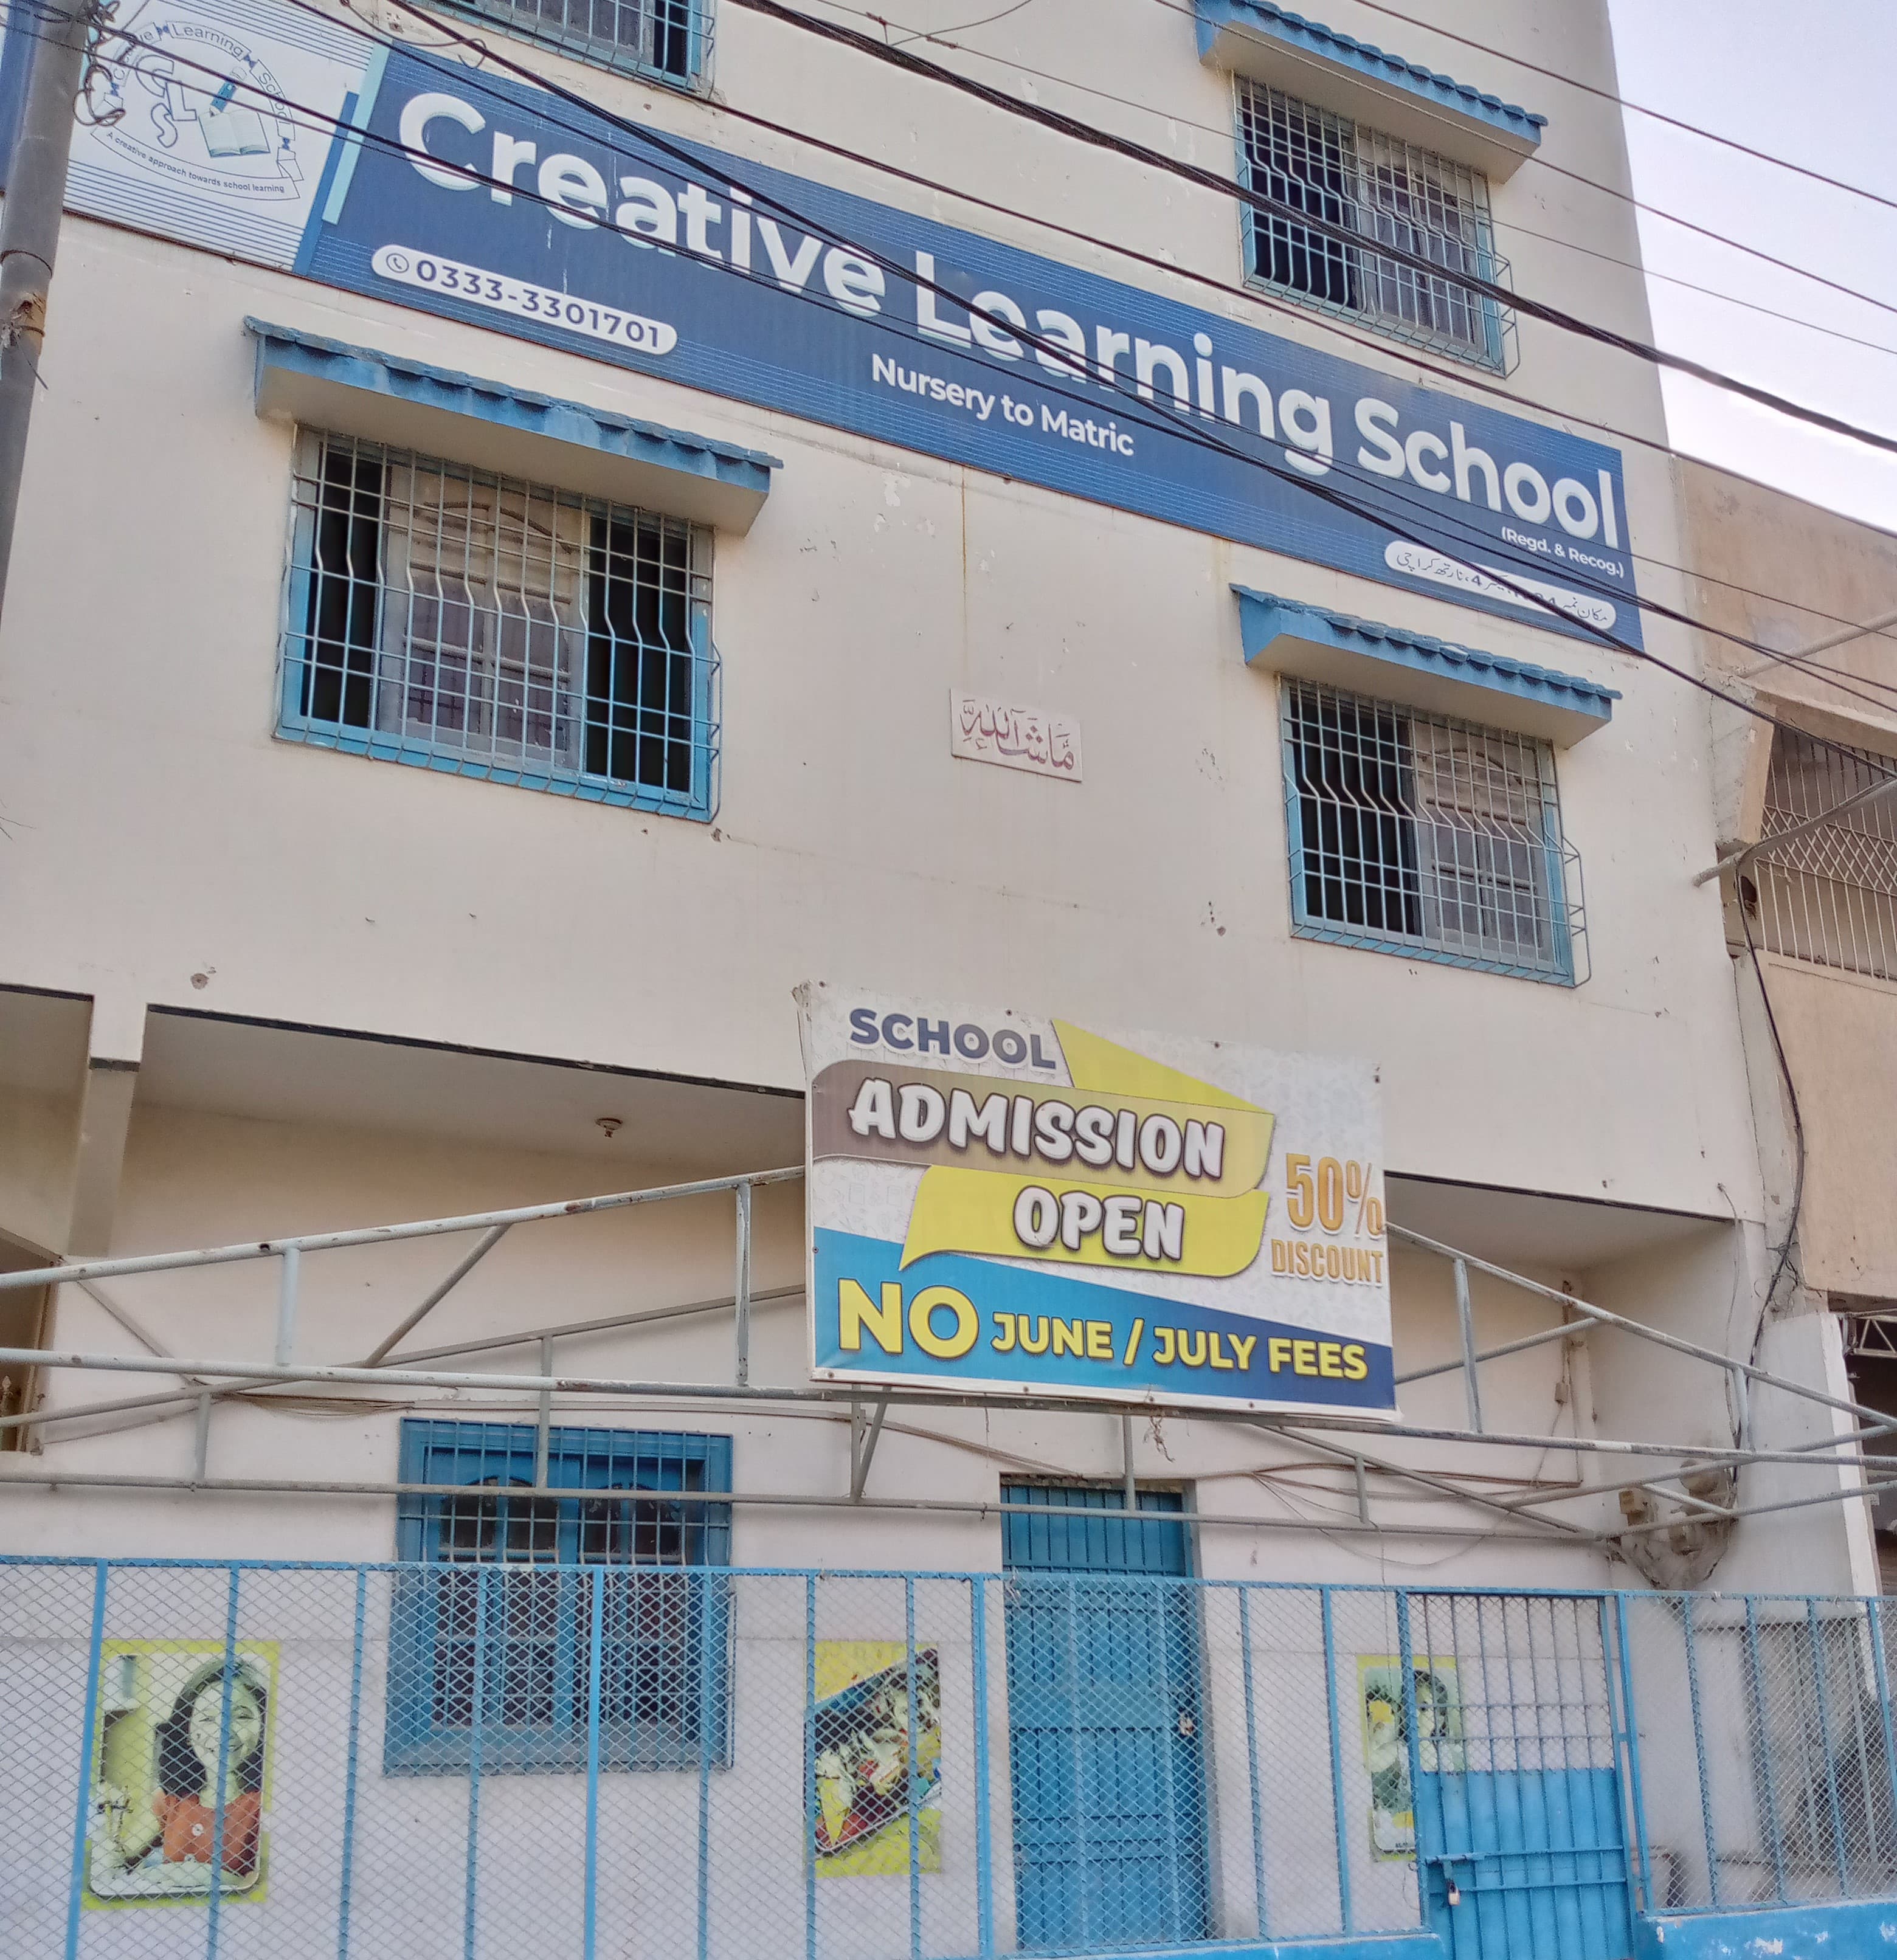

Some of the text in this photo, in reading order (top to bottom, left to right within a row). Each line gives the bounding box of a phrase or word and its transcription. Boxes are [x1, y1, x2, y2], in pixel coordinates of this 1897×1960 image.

[172, 23, 244, 57] Learning
[115, 137, 147, 159] creative
[148, 156, 187, 177] approach
[188, 171, 221, 186] towards
[223, 180, 251, 192] school
[252, 184, 285, 193] learning
[399, 92, 1619, 548] Creative Learning School
[416, 259, 660, 348] 0333-3301701
[871, 354, 1135, 457] Nursery to Matric
[1396, 552, 1440, 572] کراچی
[1501, 526, 1625, 579] (Regd. & Recog.)
[849, 1007, 1057, 1070] SCHOOL
[848, 1077, 1225, 1180] ADMISSION
[1014, 1185, 1185, 1260] OPEN
[1285, 1152, 1384, 1239] 50%
[1270, 1238, 1384, 1285] DISCOUNT
[837, 1278, 980, 1359] NO
[992, 1312, 1114, 1360] JUNE
[1152, 1326, 1256, 1370] JULY
[1268, 1336, 1369, 1381] FEES
